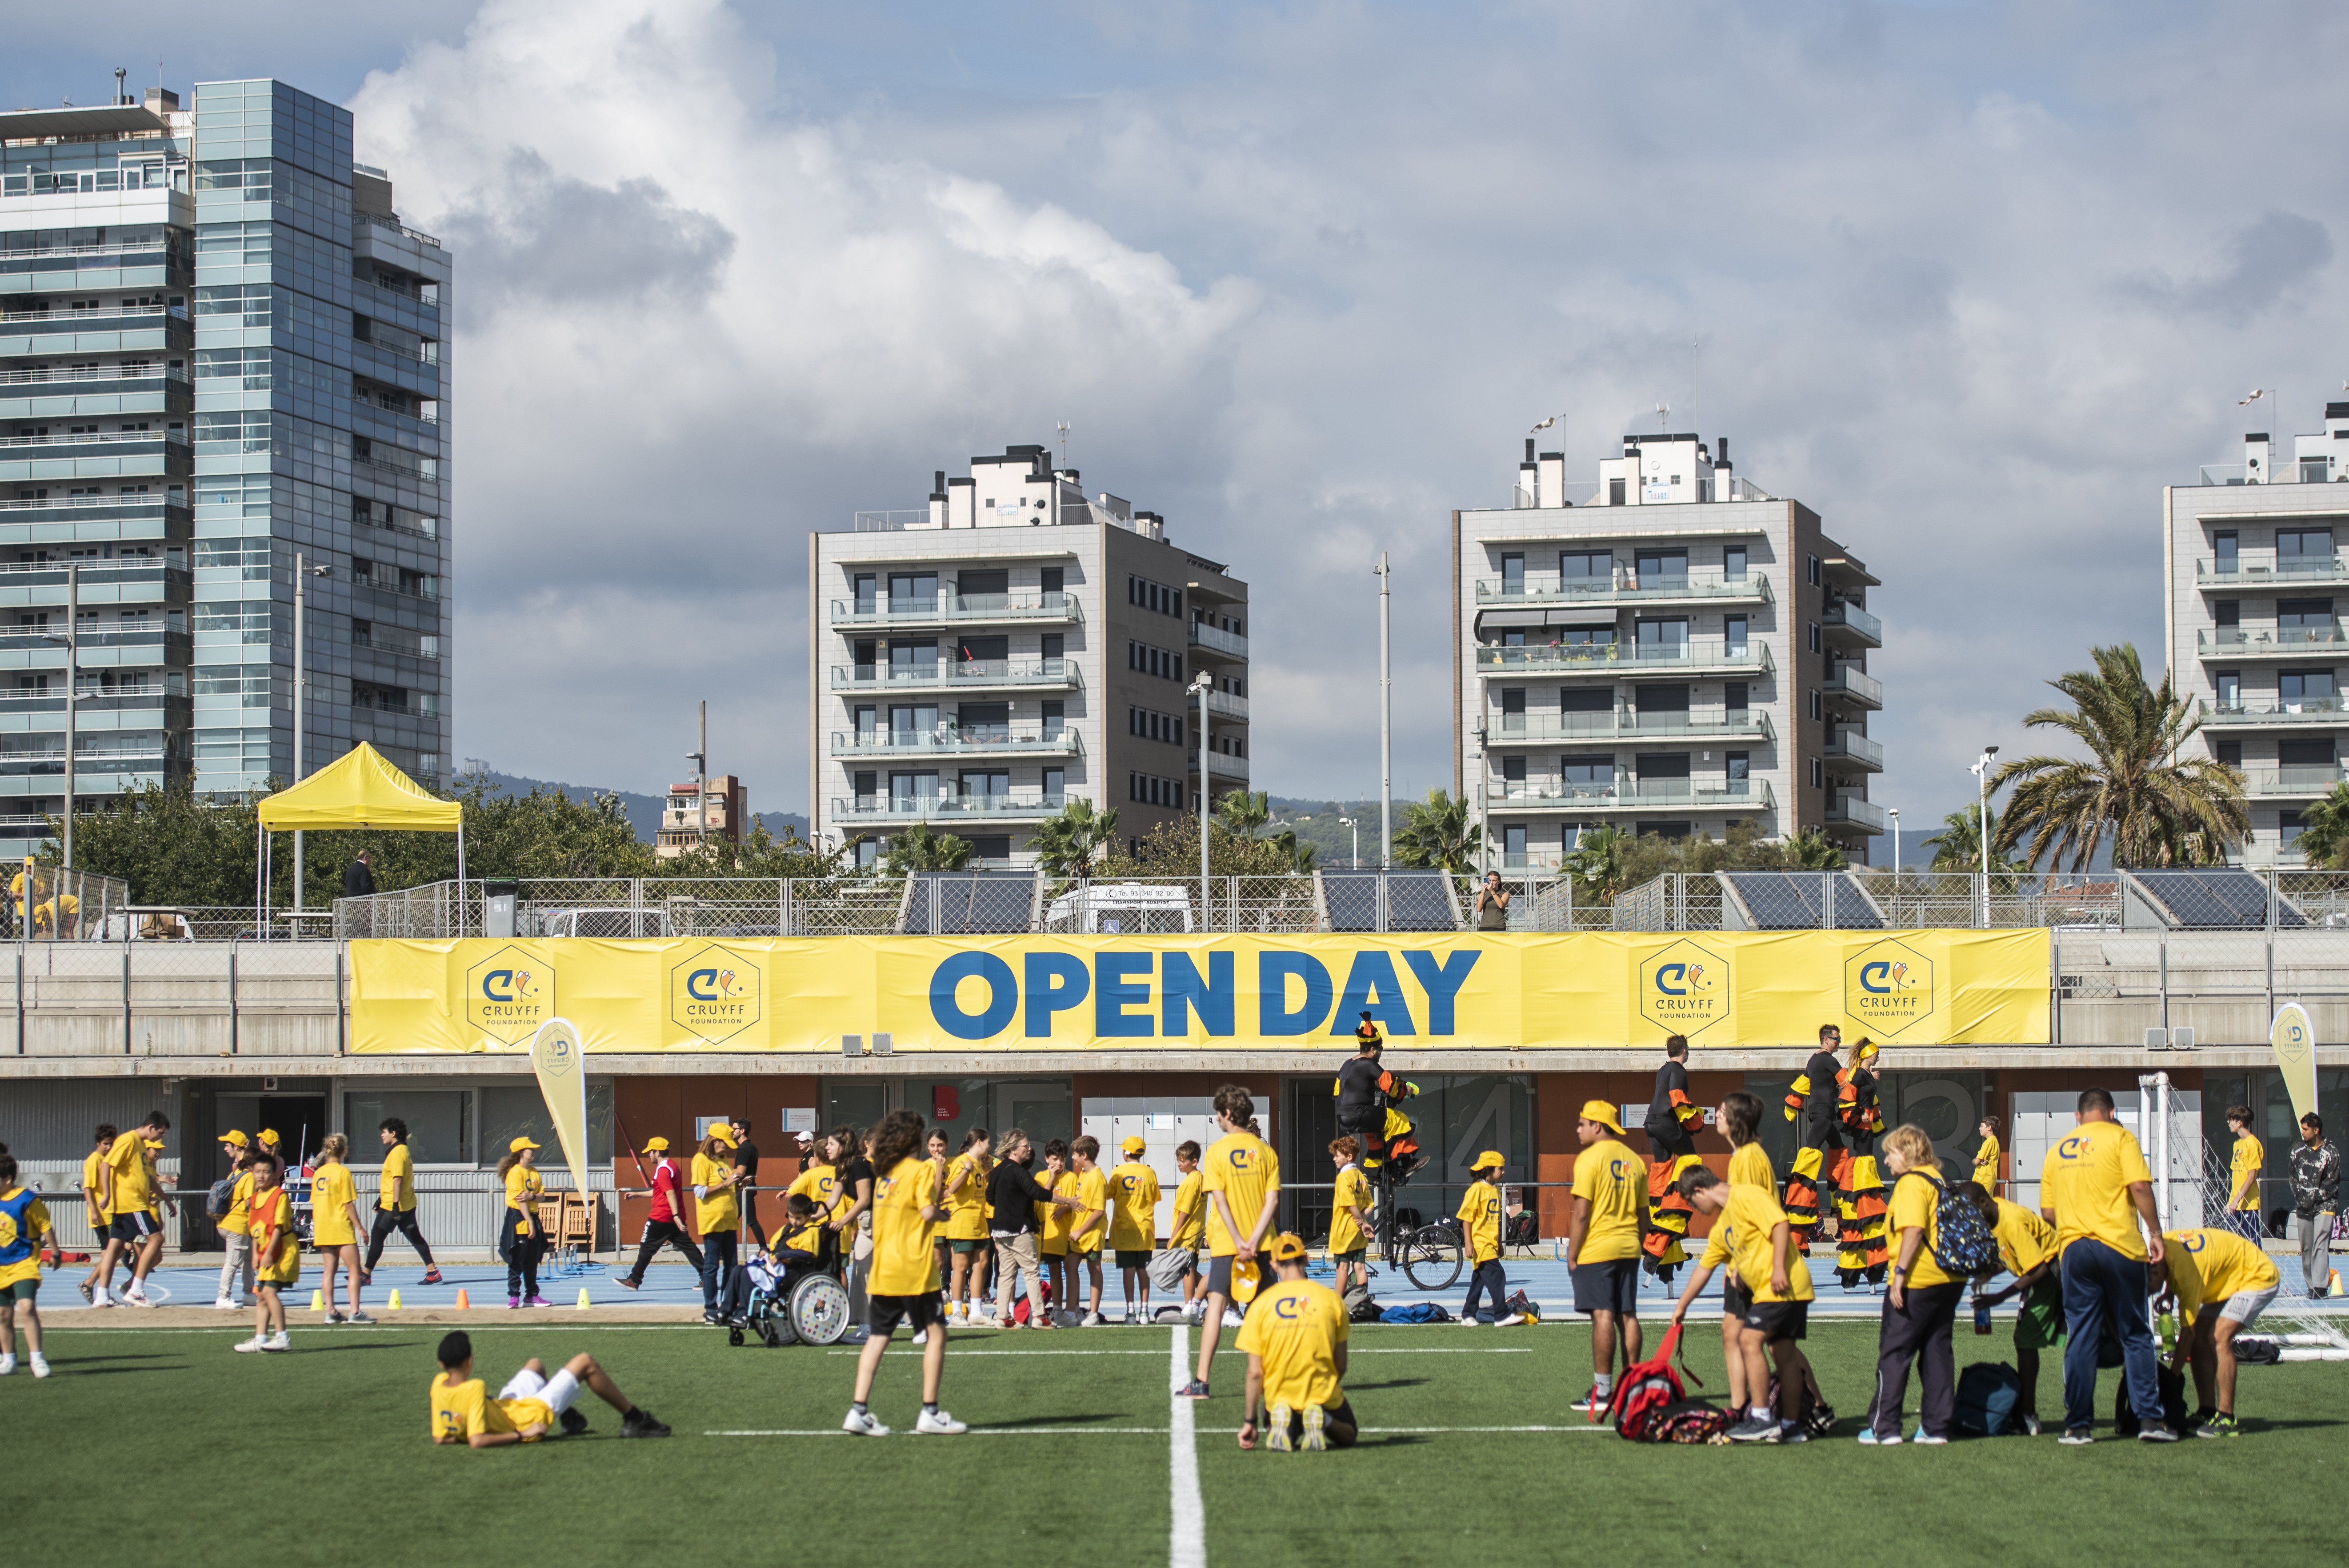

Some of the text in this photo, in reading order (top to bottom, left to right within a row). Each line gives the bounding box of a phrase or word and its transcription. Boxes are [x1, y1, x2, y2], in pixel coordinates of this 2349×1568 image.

[929, 950, 1482, 1040] OPEN DAY
[1656, 1000, 1713, 1009] CRUYFF
[1860, 997, 1917, 1008] CRUYFF
[483, 1006, 540, 1016] CRUYFF
[687, 1005, 744, 1015] CRUYFF
[1447, 1084, 1525, 1182] 4
[1904, 1079, 1975, 1179] 3
